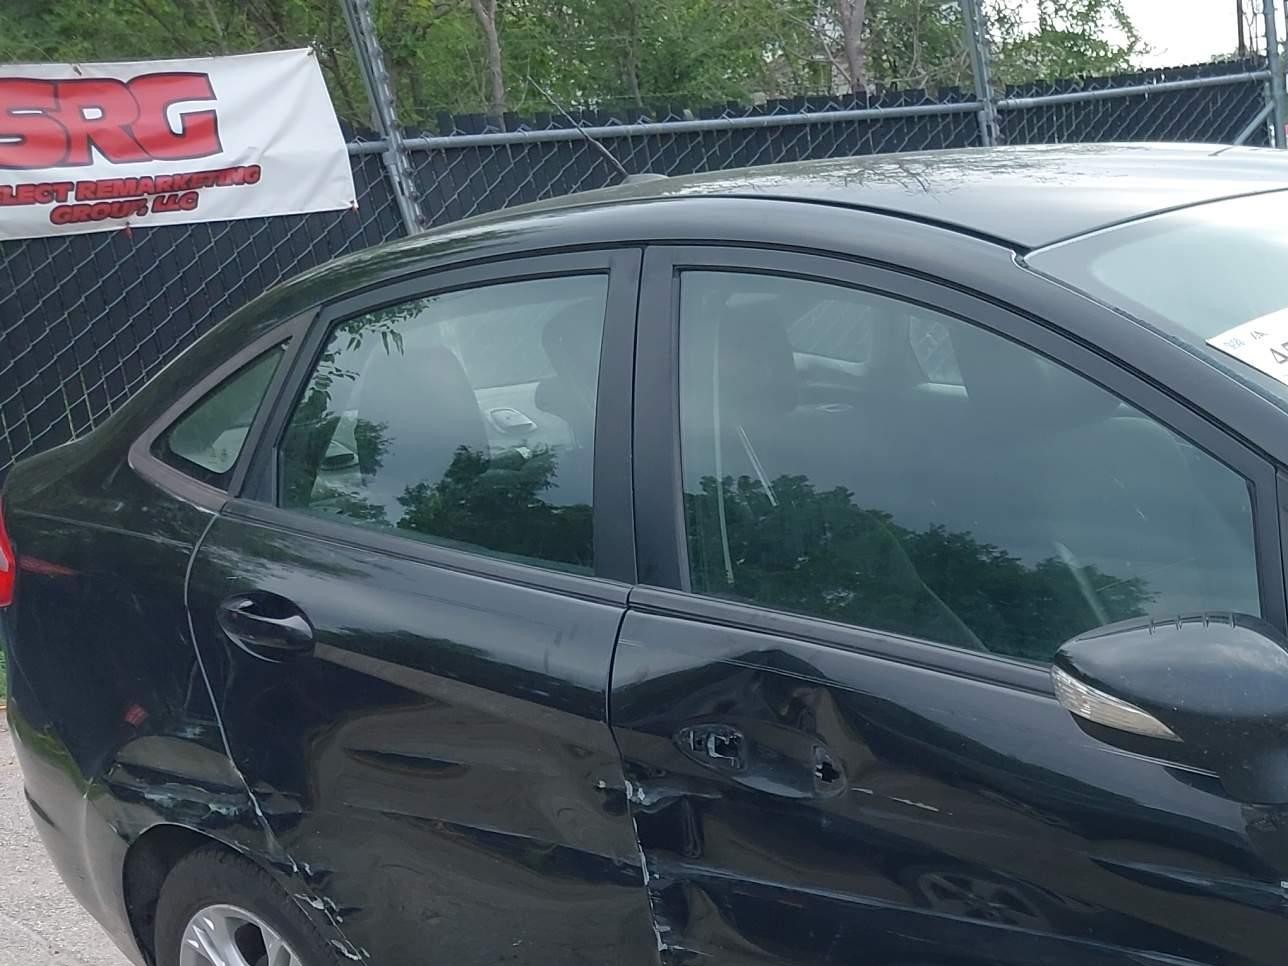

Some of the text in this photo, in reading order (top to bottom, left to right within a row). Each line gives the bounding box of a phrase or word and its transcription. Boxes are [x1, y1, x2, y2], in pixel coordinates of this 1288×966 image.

[0, 72, 223, 170] SRG
[75, 165, 261, 201] REMARKETING
[151, 191, 199, 213] LLC
